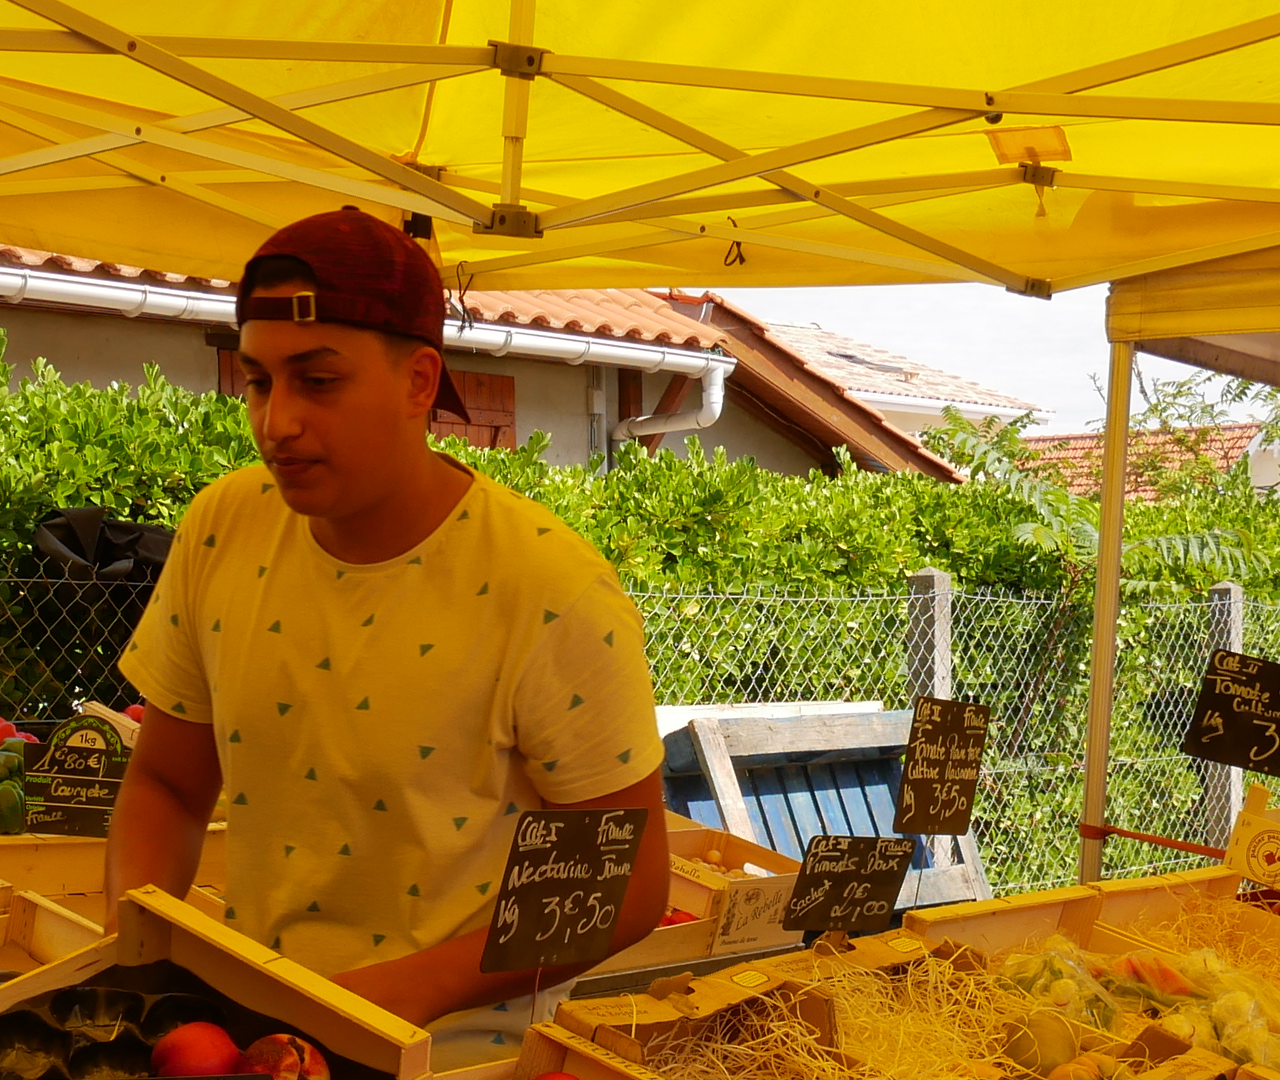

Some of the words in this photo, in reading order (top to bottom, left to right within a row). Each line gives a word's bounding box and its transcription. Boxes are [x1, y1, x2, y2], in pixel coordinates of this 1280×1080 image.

[1214, 651, 1241, 672] Cat
[1207, 674, 1270, 703] Tomate
[79, 732, 97, 747] 1kg
[910, 735, 946, 760] Tomate
[25, 775, 52, 784] Produit
[518, 816, 547, 846] Cat
[597, 810, 634, 845] France
[811, 836, 837, 853] Cat
[876, 838, 913, 853] France
[508, 851, 593, 891] Nectarine
[597, 855, 632, 881] Jaune
[806, 853, 859, 875] Piments
[735, 916, 749, 931] La
[751, 889, 782, 921] Rebelle
[790, 880, 833, 919] Sachet
